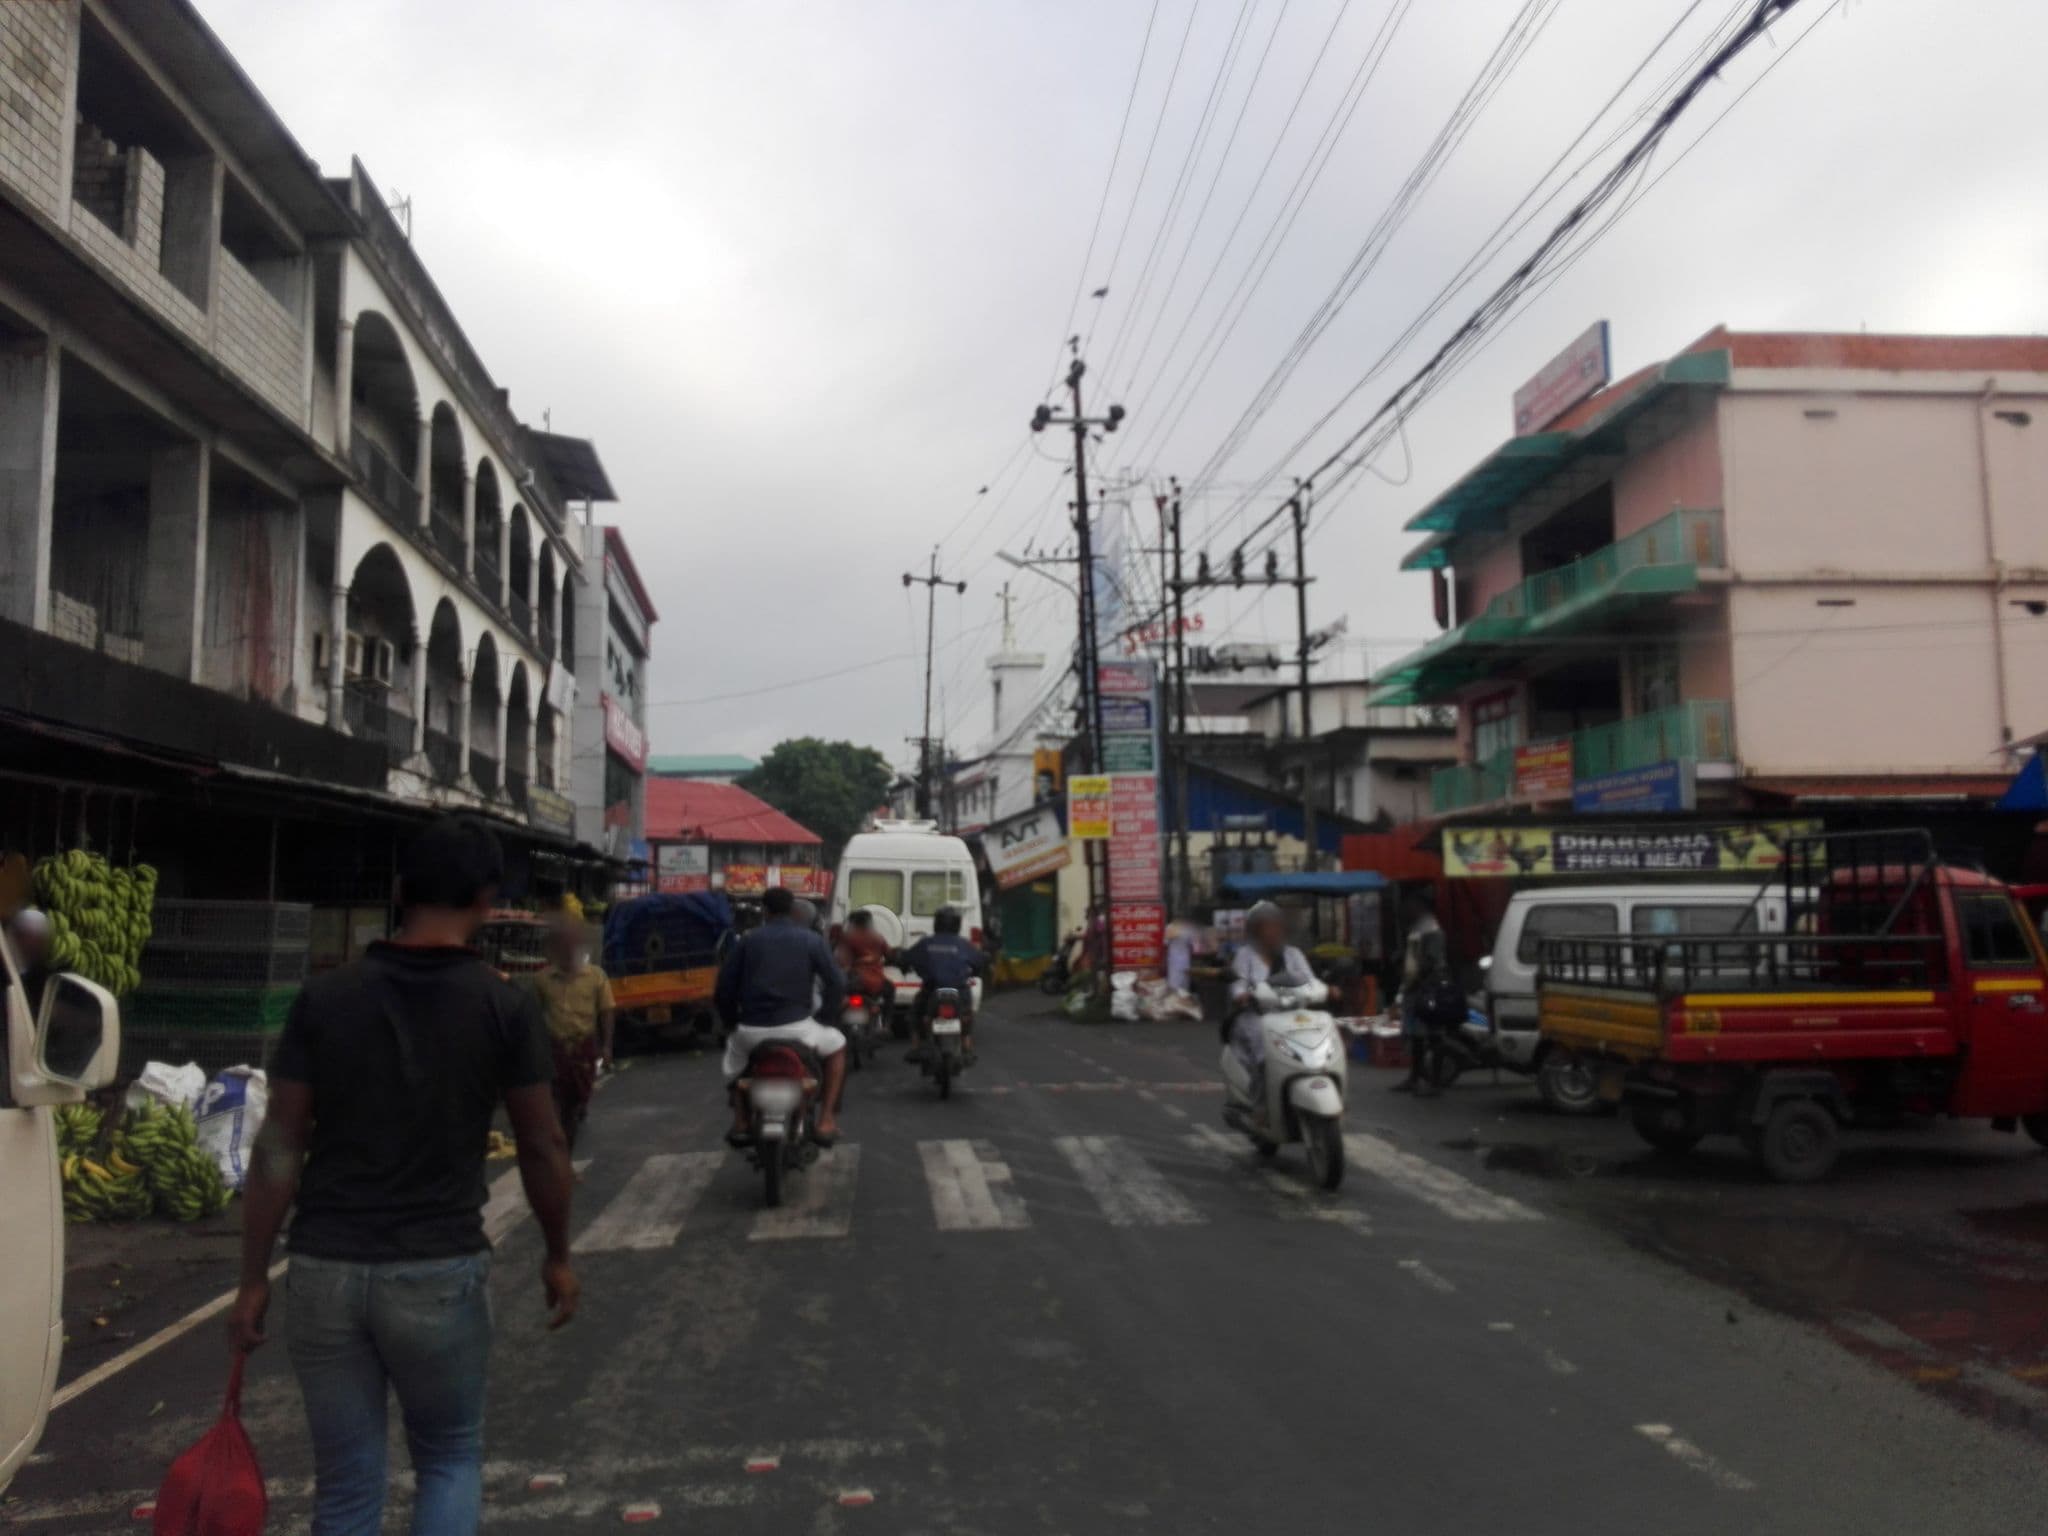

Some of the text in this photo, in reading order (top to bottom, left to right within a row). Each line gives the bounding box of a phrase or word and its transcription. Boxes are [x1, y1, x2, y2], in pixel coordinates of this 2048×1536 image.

[1001, 816, 1041, 849] AVT
[1566, 851, 1706, 868] FRESH MEAT
